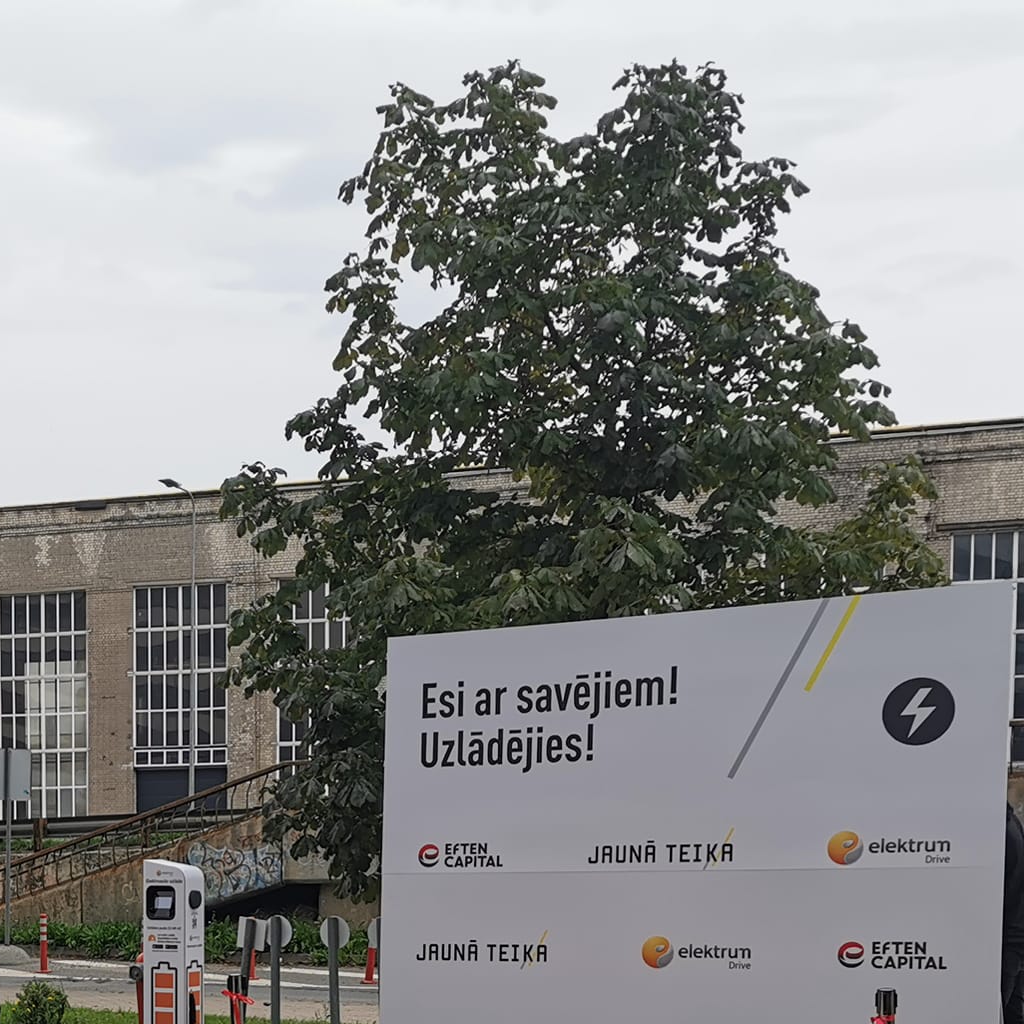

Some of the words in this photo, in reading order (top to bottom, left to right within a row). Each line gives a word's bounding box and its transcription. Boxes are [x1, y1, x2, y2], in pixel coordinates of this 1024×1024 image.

[422, 681, 464, 719] Esi
[475, 687, 507, 716] ar
[517, 665, 678, 719] savējiem!
[421, 724, 594, 773] Uzlādējies!
[588, 840, 657, 864] JAUNĀ
[666, 843, 734, 863] TEIKA
[869, 838, 951, 853] elektrum
[444, 855, 503, 868] CAPITAL
[925, 855, 951, 863] Drive
[416, 940, 478, 962] JAUNĀ
[487, 943, 548, 962] TEIKA
[678, 944, 751, 959] elektrum
[728, 961, 752, 970] Drive
[870, 956, 947, 970] CAPITAL
